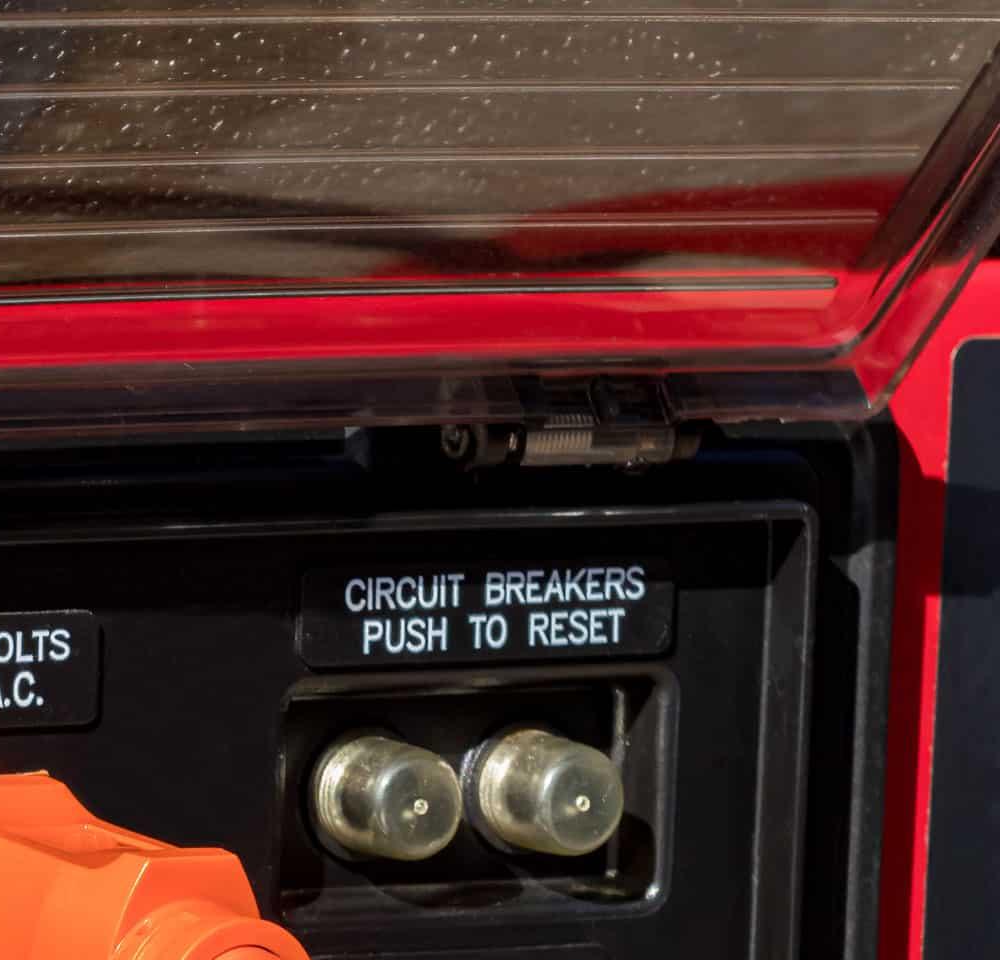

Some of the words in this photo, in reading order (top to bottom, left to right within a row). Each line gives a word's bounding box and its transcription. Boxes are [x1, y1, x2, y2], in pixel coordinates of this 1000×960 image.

[345, 574, 465, 612] CIRCUIT
[485, 566, 646, 607] BREAKERS
[362, 616, 448, 655] PUSH
[468, 613, 508, 649] TO
[528, 607, 626, 647] RESET
